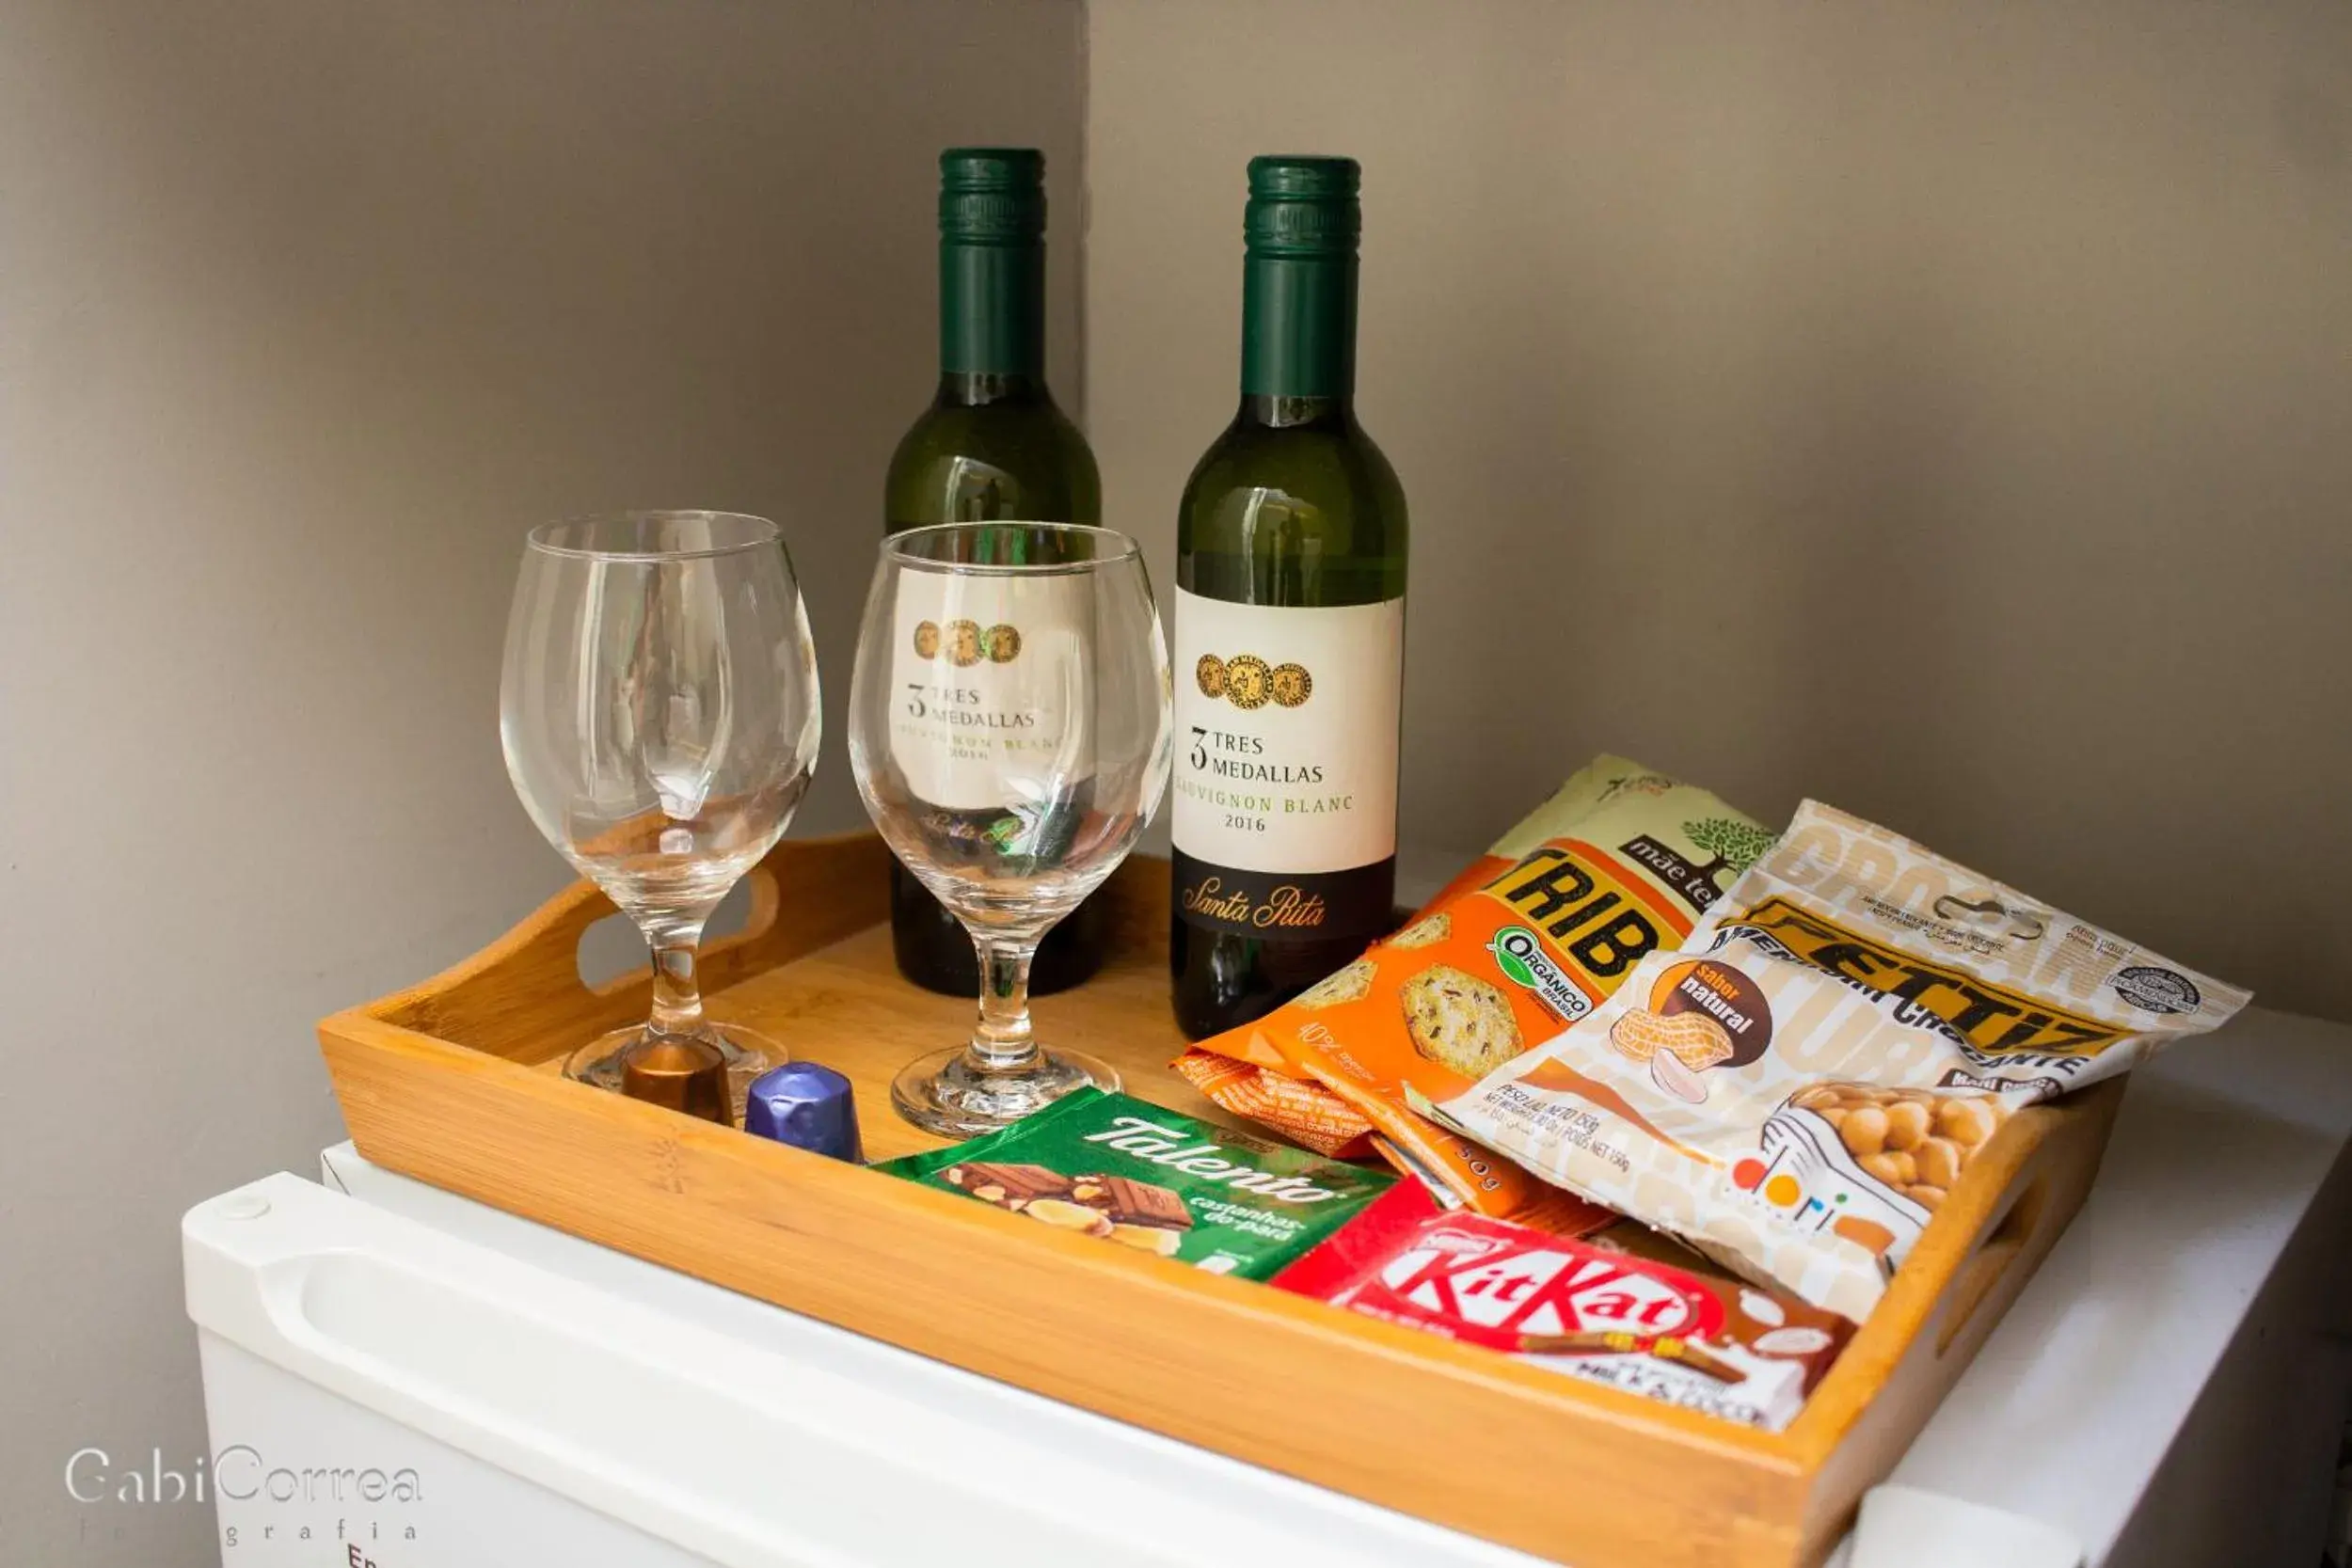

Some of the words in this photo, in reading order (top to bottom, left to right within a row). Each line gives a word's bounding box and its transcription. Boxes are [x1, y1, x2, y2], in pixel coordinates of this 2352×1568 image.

[907, 683, 927, 719] 3
[932, 709, 1036, 729] MEDALLAS
[1191, 725, 1208, 770] 3
[1213, 731, 1263, 755] TRES
[1213, 757, 1323, 784] MEDALLAS
[1225, 814, 1265, 832] 2016
[1284, 796, 1353, 814] BLANC
[1629, 841, 1686, 880] mãe
[1183, 876, 1250, 923] Santa
[1252, 885, 1326, 927] Rita
[1696, 964, 1740, 1001] sabor
[1680, 976, 1754, 1034] natural
[1083, 1117, 1334, 1202] Talento
[1391, 1246, 1682, 1336] KitKat
